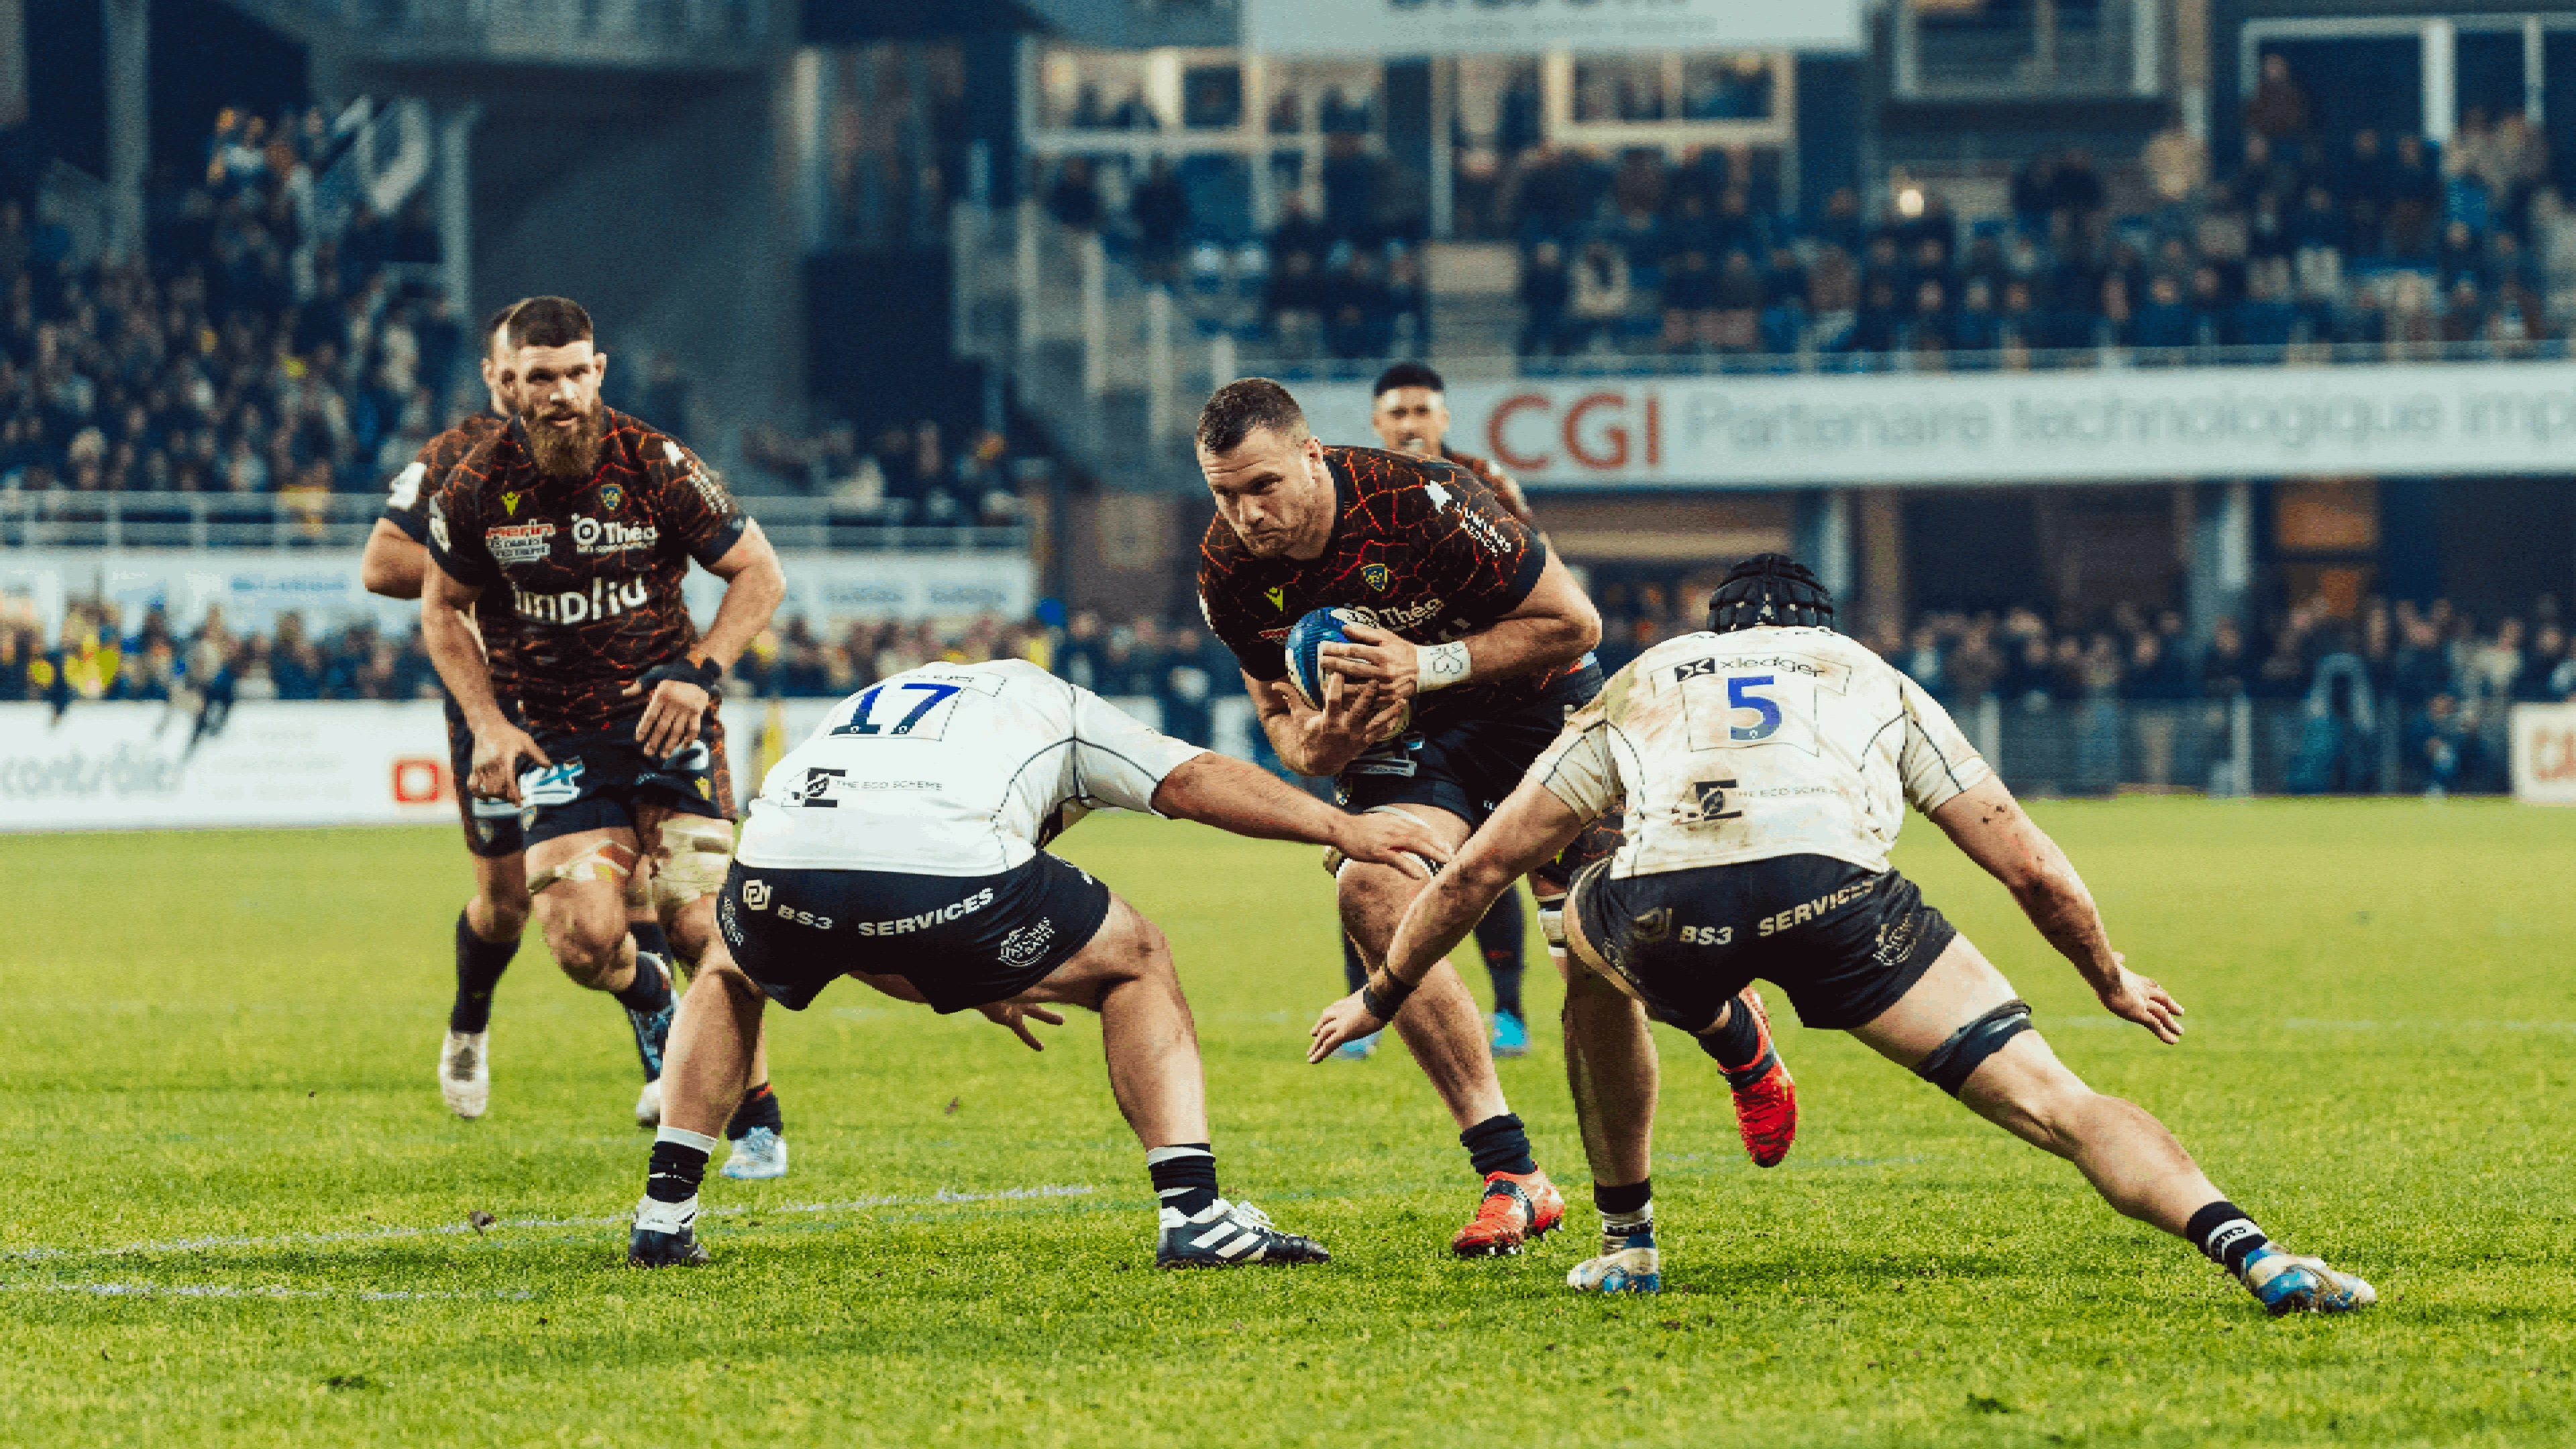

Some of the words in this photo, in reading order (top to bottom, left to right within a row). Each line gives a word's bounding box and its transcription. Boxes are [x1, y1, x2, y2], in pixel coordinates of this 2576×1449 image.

[1485, 393, 1660, 471] CGI
[1684, 391, 1994, 449] Partenaire
[2012, 388, 2445, 456] technologique
[1719, 657, 1825, 677] xledger
[829, 683, 961, 735] 17
[1728, 676, 1782, 740] 5
[777, 904, 833, 930] BS3
[859, 888, 994, 936] SERVICES
[1680, 925, 1733, 945] BS3
